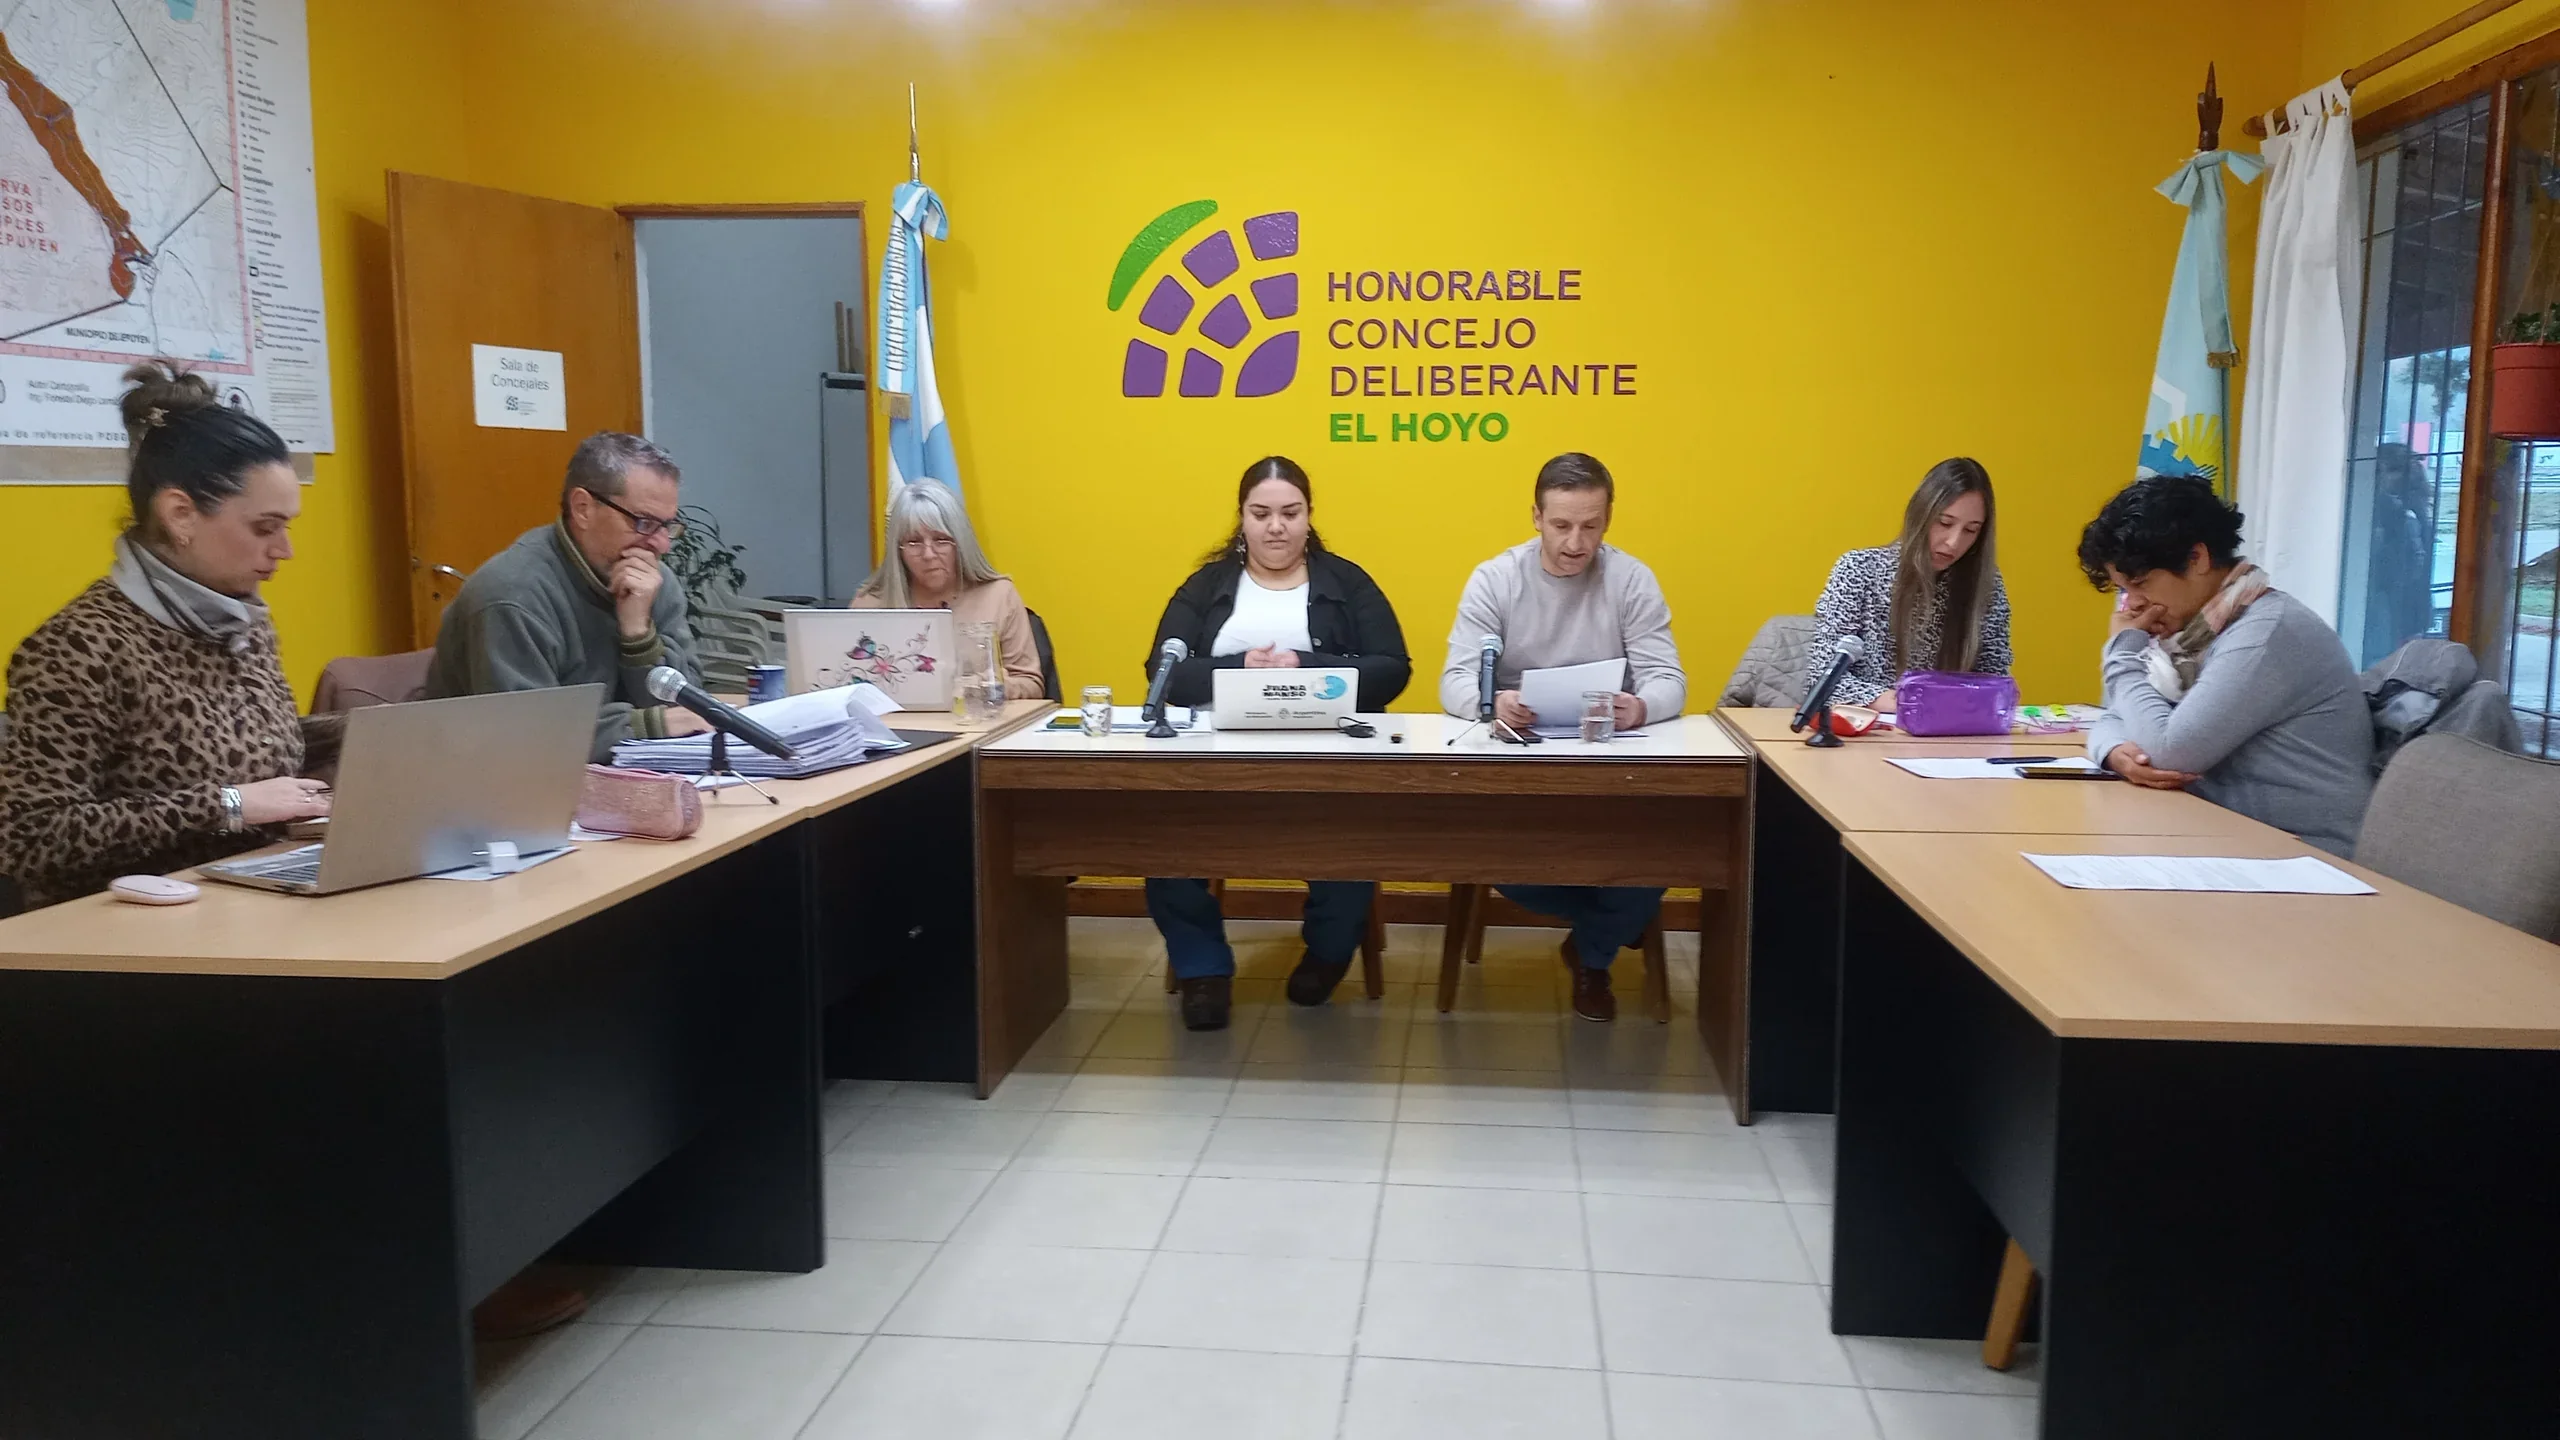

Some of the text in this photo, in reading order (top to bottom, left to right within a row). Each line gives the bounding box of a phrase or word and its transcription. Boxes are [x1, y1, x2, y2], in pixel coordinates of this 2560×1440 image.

[1327, 269, 1582, 302] HONORABLE
[1328, 317, 1536, 350] CONCEJO
[500, 357, 540, 373] Sala de
[1331, 364, 1637, 396] DELIBERANTE
[491, 373, 550, 392] Concejales
[1330, 412, 1509, 442] EL HOYO
